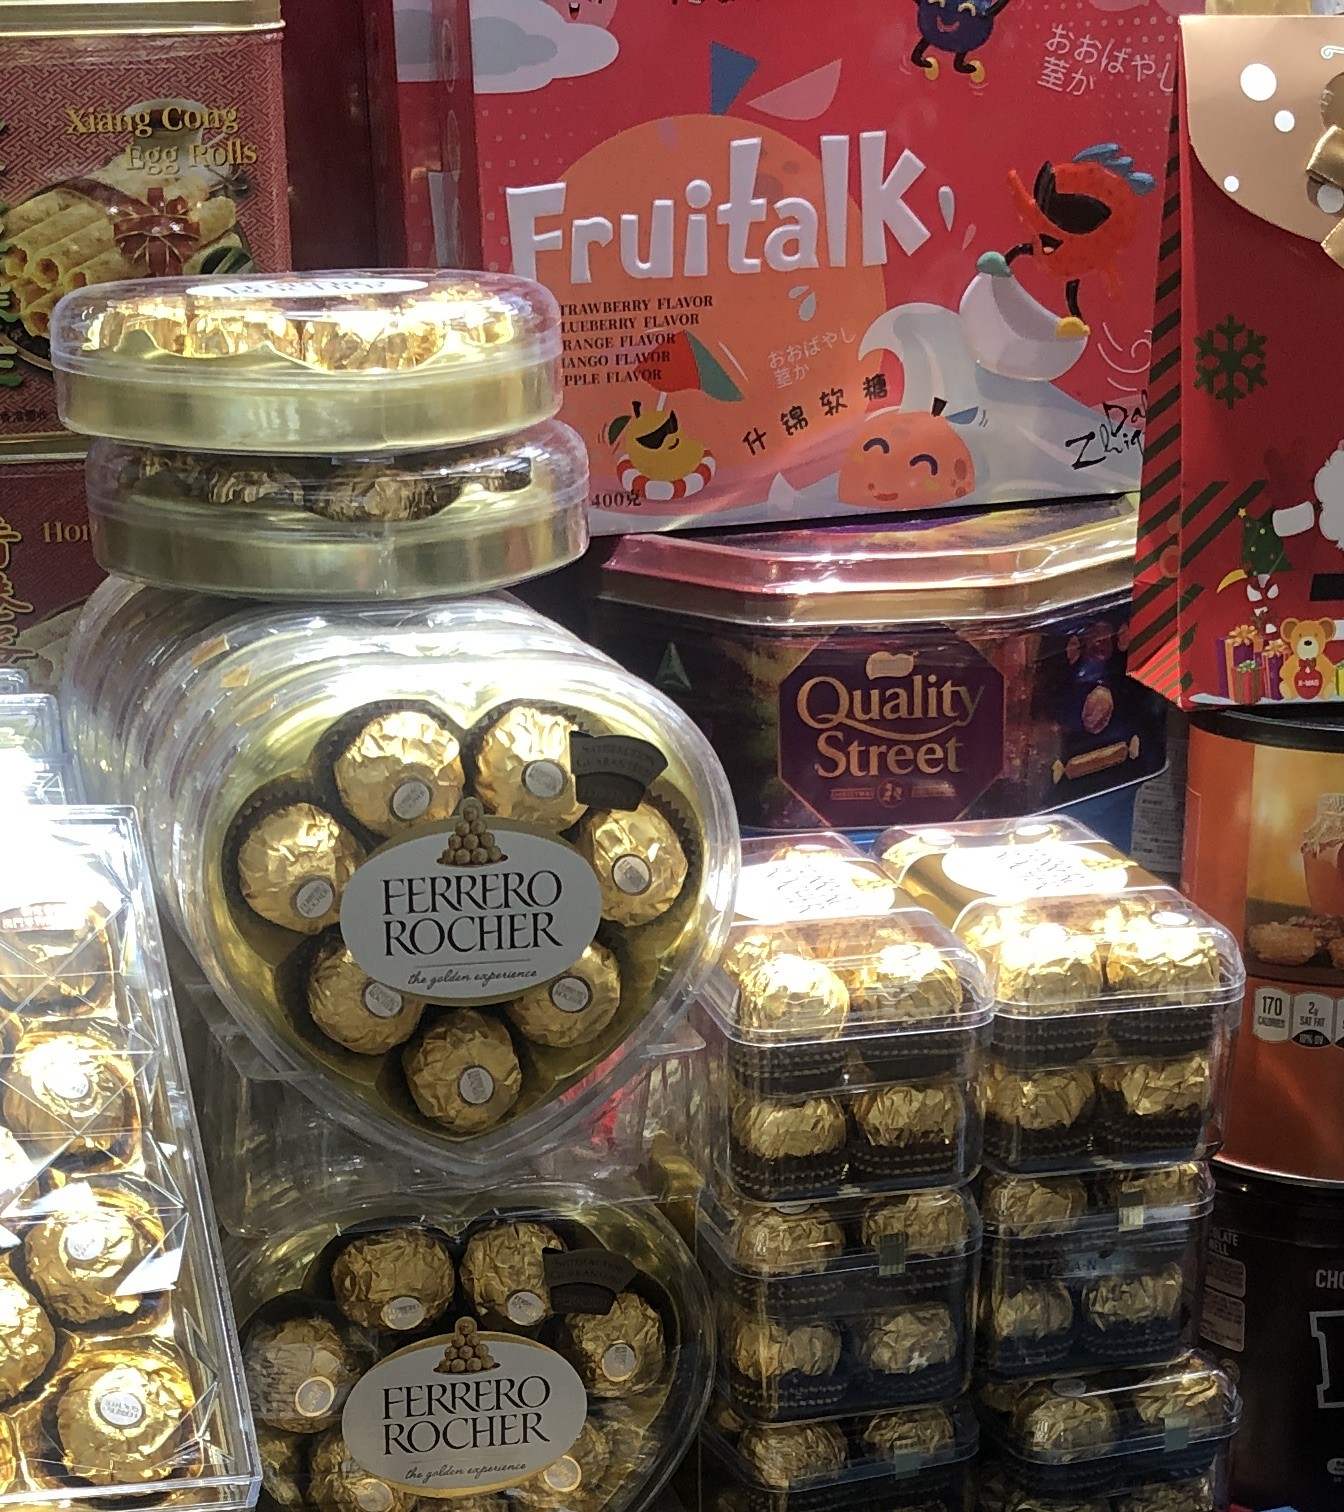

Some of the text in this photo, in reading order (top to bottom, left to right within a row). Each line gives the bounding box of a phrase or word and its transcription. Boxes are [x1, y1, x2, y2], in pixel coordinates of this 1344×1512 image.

[65, 104, 239, 138] Xiang Cong
[126, 139, 259, 175] Egg Rolls
[506, 130, 936, 285] Fruitalk
[559, 295, 714, 318] TRAWBERRY FLAVOR
[560, 313, 700, 335] LUEBERRY FLAVOR
[562, 331, 676, 351] RANGE FLAVOR
[615, 350, 671, 365] FLAVOR
[563, 372, 600, 387] PPLE
[741, 373, 889, 456] 什锦软糖
[796, 674, 986, 741] Quality
[813, 732, 964, 778] Street
[381, 869, 564, 916] FERRERO
[381, 912, 564, 957] ROCHER
[408, 968, 538, 991] the golden experience
[1261, 995, 1283, 1016] 170
[381, 1375, 552, 1421] FERRERO
[382, 1412, 551, 1457] ROCHER
